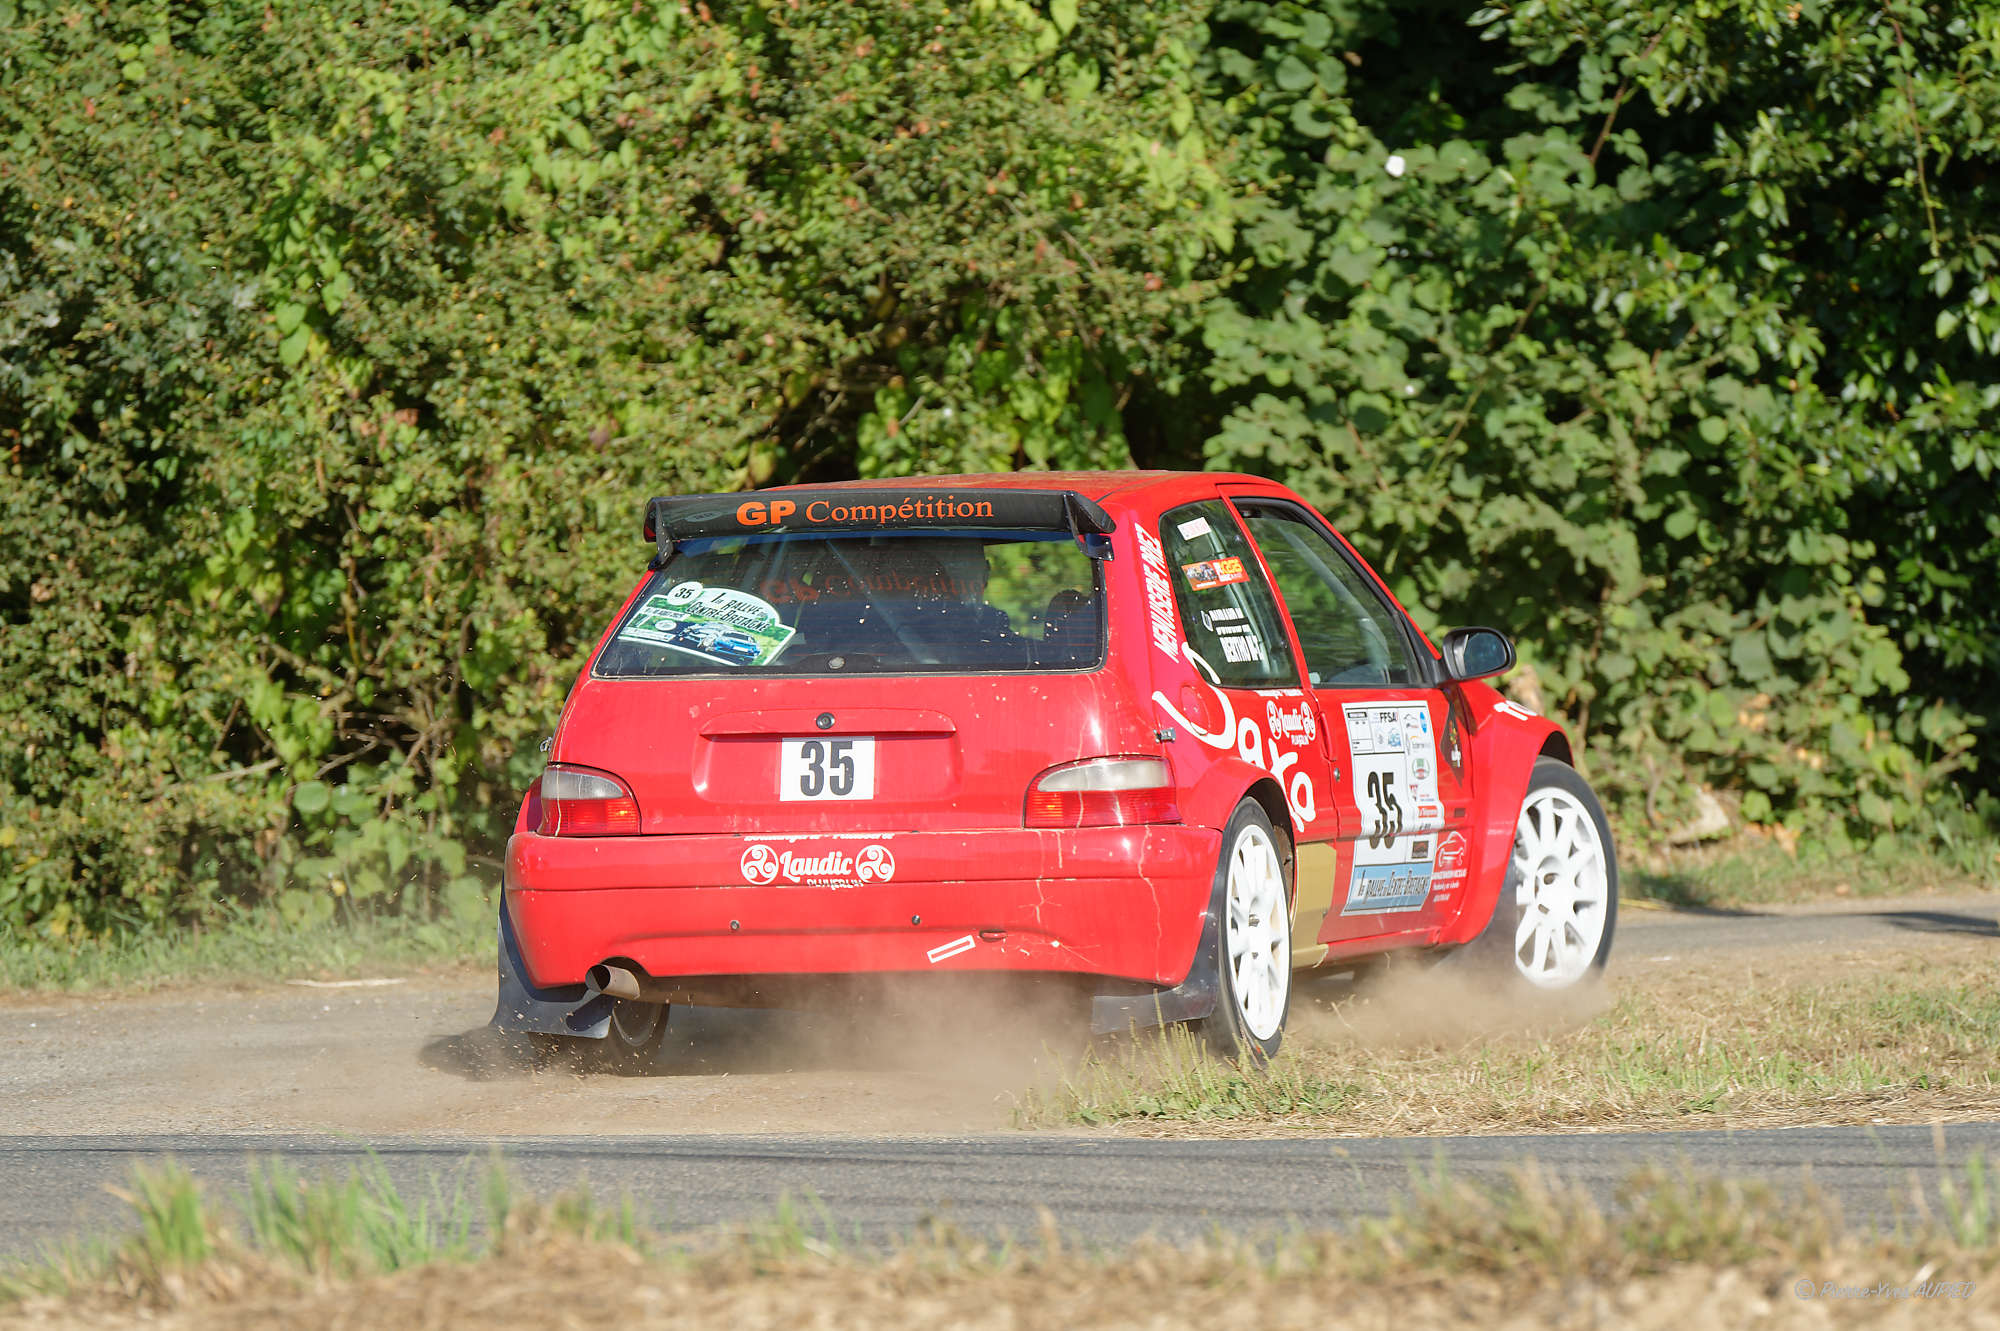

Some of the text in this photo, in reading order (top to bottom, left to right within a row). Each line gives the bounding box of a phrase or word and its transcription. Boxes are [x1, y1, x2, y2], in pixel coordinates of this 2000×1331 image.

[736, 495, 995, 526] GP Compétition
[675, 587, 695, 600] 35
[720, 599, 763, 615] RALLYE
[1134, 522, 1181, 664] MENUISERIE PRIEZ
[800, 740, 854, 797] 35
[1367, 770, 1403, 850] 35
[779, 850, 854, 884] Laudic
